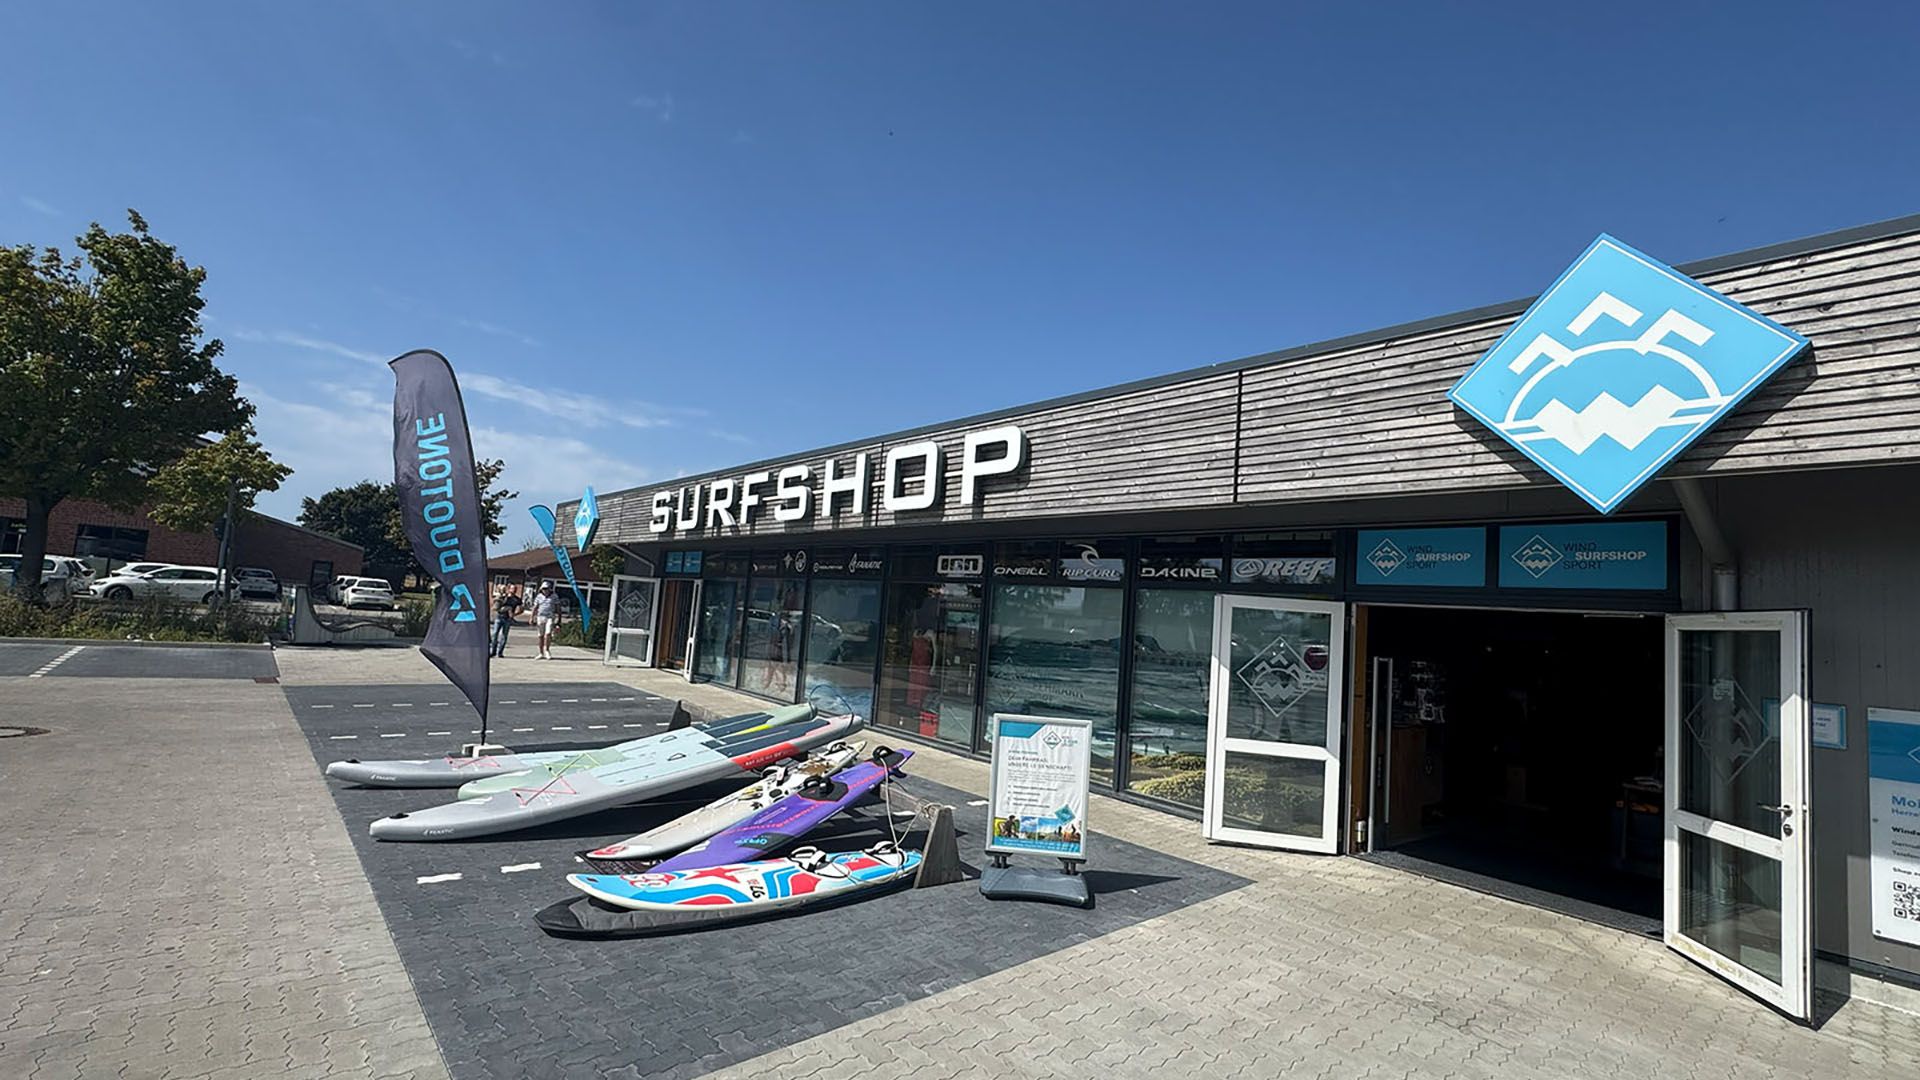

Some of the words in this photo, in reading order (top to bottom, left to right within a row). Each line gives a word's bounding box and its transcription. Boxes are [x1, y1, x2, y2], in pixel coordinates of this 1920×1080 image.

[649, 426, 1026, 533] SURFSHOP
[1563, 542, 1597, 552] WIND
[1415, 552, 1471, 562] SURFSHOP
[1575, 551, 1647, 561] SURFSHOP
[1262, 559, 1329, 580] REEF
[1563, 560, 1602, 570] SPORT
[1141, 567, 1218, 578] DAKINE
